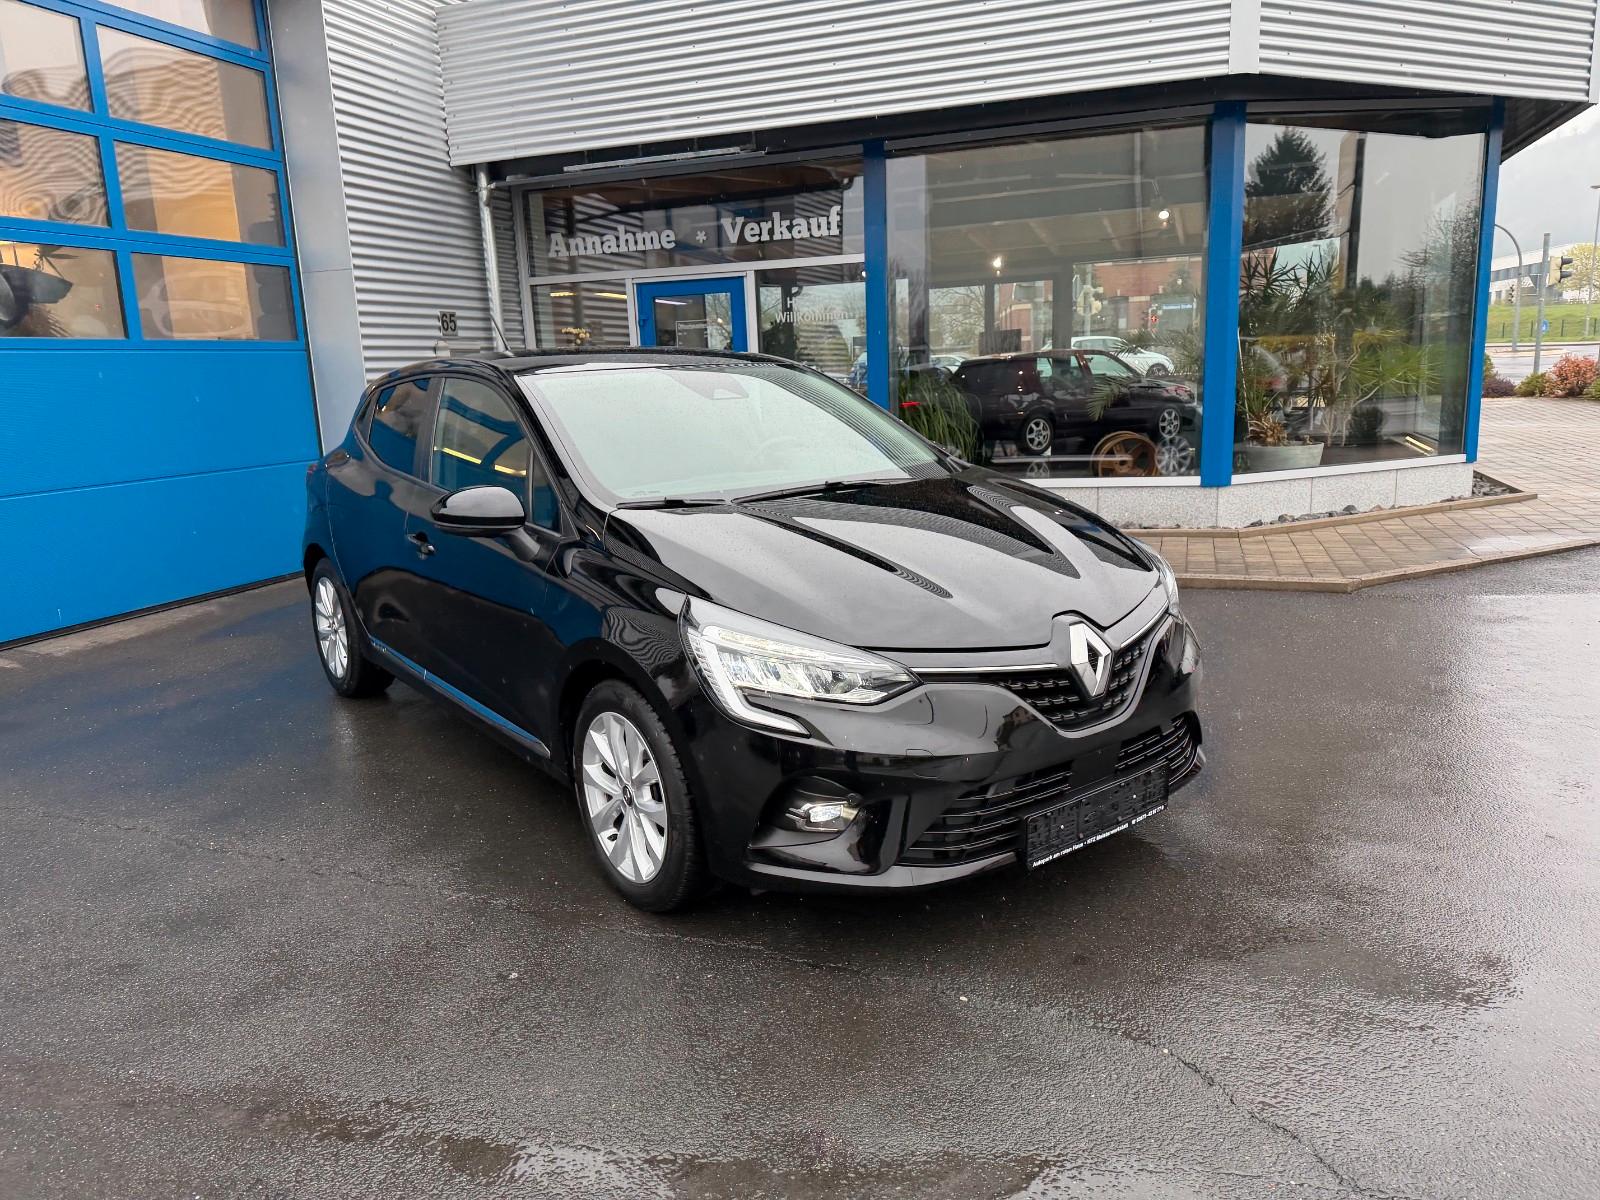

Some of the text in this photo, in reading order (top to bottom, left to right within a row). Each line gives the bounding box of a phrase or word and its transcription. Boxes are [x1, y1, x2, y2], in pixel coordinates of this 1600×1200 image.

[549, 205, 841, 257] Annahme Verkauf
[440, 313, 457, 332] 65
